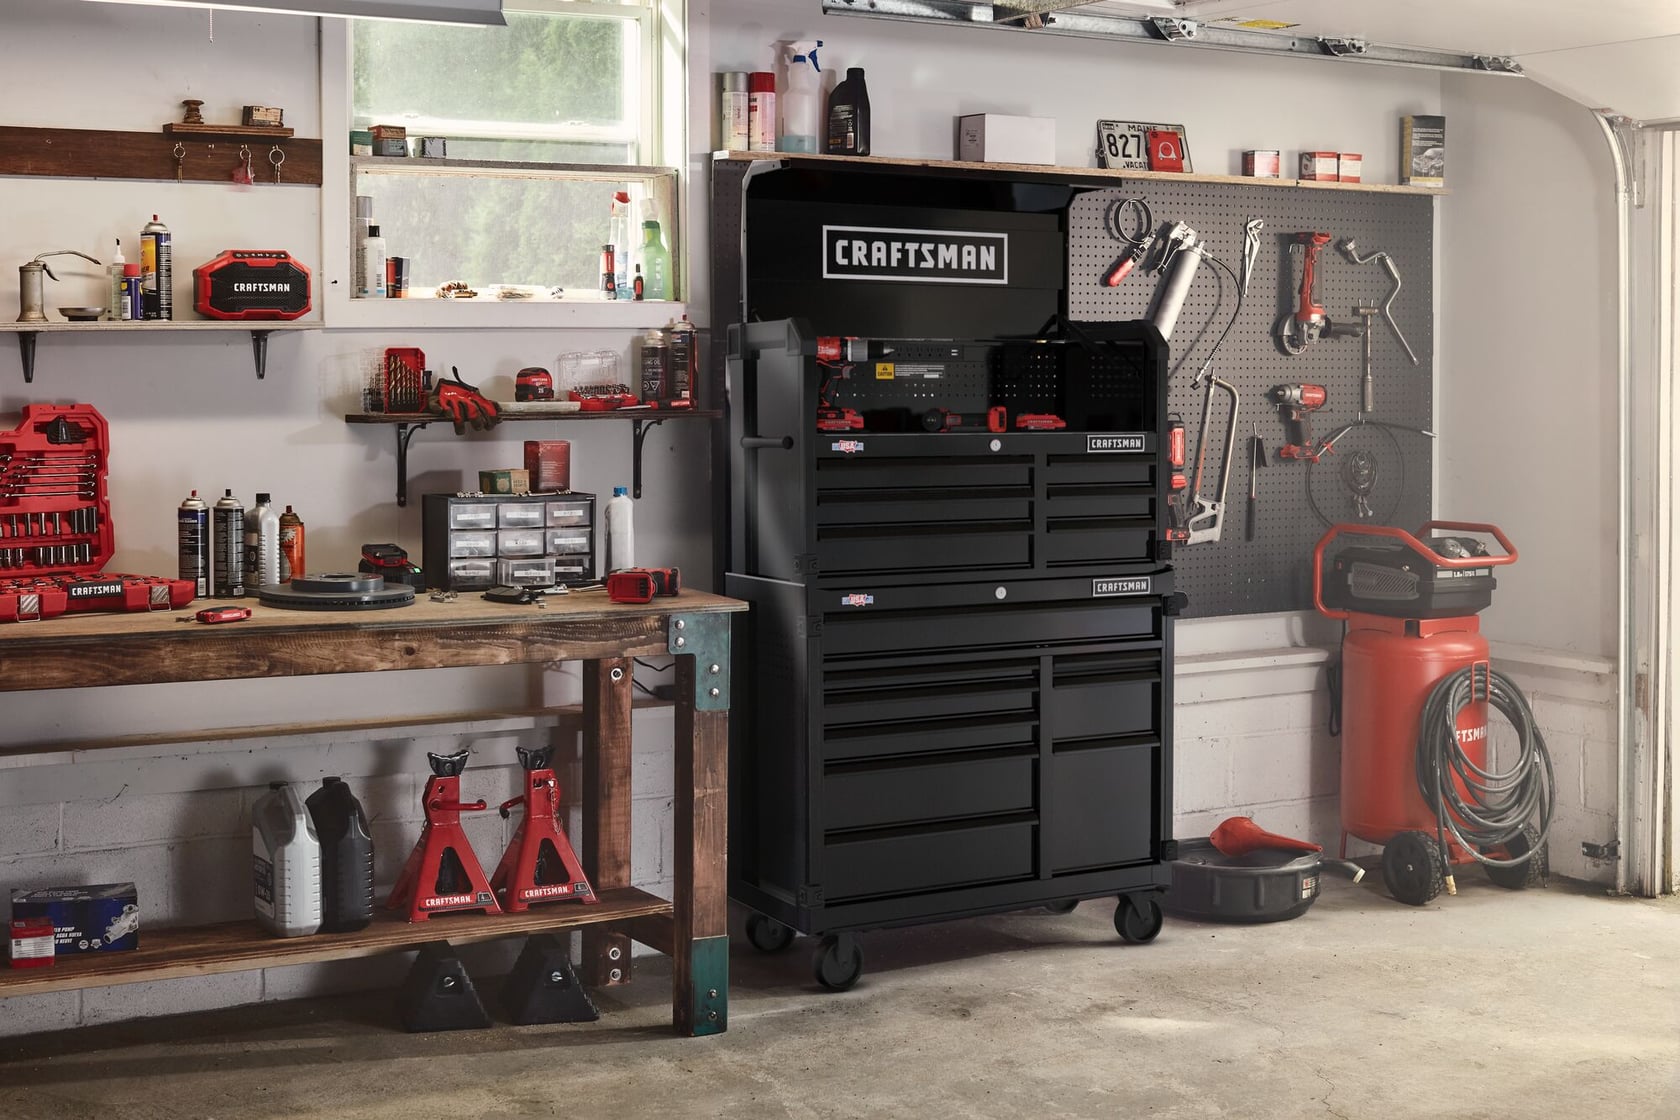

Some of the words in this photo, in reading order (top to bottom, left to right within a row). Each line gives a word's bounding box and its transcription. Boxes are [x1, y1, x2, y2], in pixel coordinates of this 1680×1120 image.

[1127, 124, 1158, 132] MAINE
[835, 239, 996, 271] CRAFTSMAN
[233, 282, 291, 292] CRAFTSMAN
[1091, 438, 1142, 449] CRAFTSMAN
[71, 584, 122, 597] CRAFTSMAN
[1097, 581, 1148, 593] CRAFTSMAN
[524, 886, 569, 898] CRAFTSMAN
[425, 895, 471, 907] CRAFTSMAN
